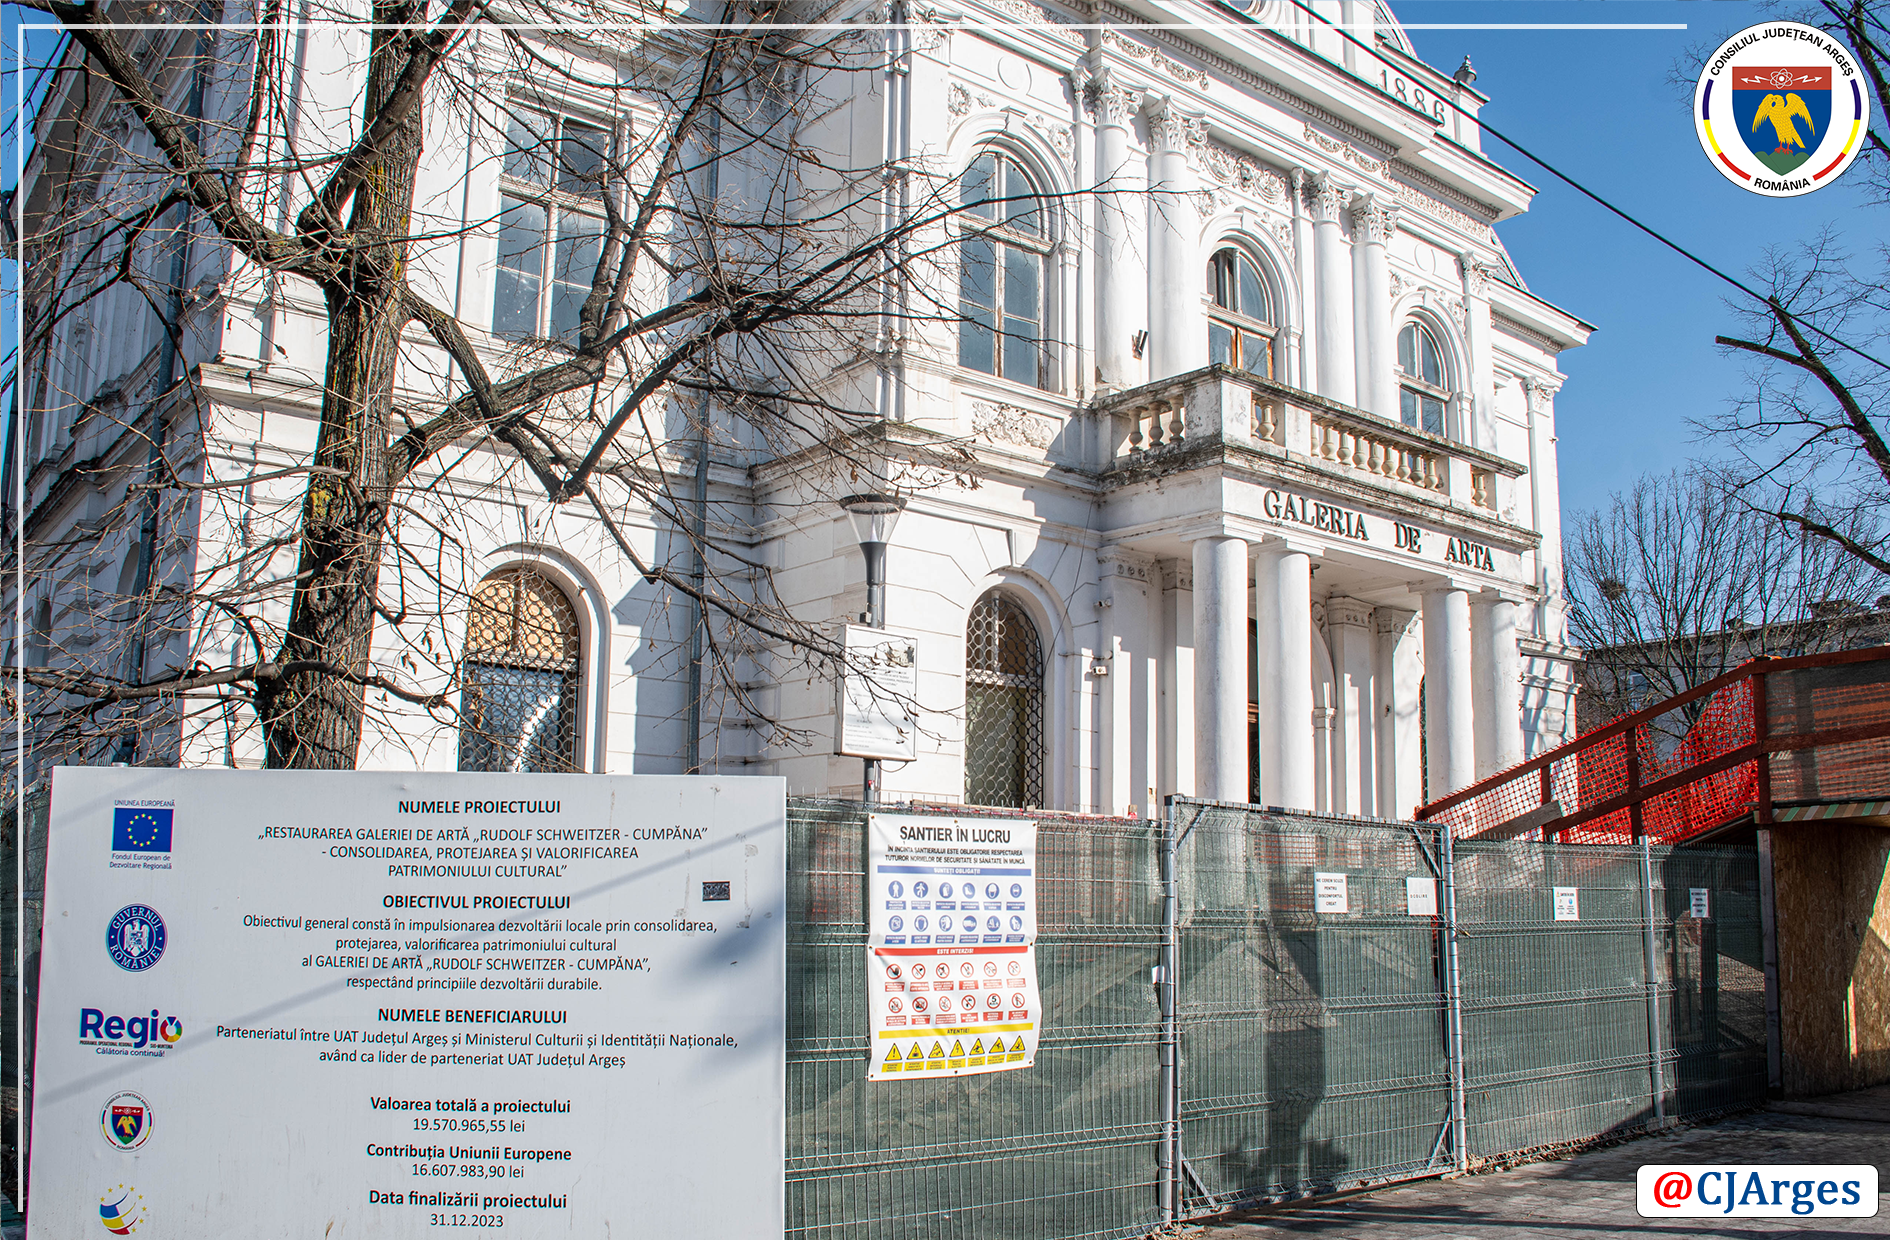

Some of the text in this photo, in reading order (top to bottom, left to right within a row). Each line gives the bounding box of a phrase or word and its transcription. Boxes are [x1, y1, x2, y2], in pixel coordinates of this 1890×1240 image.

[1379, 69, 1445, 127] 1886
[1263, 490, 1496, 572] GALERIA DE ARTA
[141, 799, 175, 807] EUROPEANĂ
[399, 801, 560, 813] NUMELE PROIECTULUI
[258, 826, 352, 840] „RESTAURAREA
[356, 828, 412, 840] GALERIEI
[417, 829, 433, 841] DE
[436, 826, 469, 841] ARTĂ
[473, 829, 532, 843] „RUDOLF
[537, 829, 620, 841] SCHWEITZER
[633, 825, 707, 840] CUMPĂNA”
[956, 825, 968, 842] ÎN
[972, 830, 1011, 843] LUCRU
[330, 846, 432, 861] CONSOLIDAREA,
[437, 847, 517, 859] PROTEJAREA
[536, 847, 638, 859] VALORIFICAREA
[960, 848, 990, 856] OBLIGATORIE
[389, 865, 567, 877] PATRIMONIULUI CULTURAL”
[383, 895, 570, 909] OBIECTIVUL PROIECTULUI
[112, 907, 164, 931] GUVERNUL
[244, 915, 717, 934] Obiectivul general constă în impulsionarea dezvoltării locale prin consolidarea,
[336, 937, 616, 953] protejarea, valorificarea patrimoniului cultural
[110, 945, 162, 969] ROMÂNIEI
[302, 955, 312, 966] al
[316, 955, 368, 968] GALERIEI
[373, 957, 388, 969] DE
[391, 954, 423, 969] ARTĂ
[426, 958, 482, 971] „RUDOLF
[486, 958, 565, 970] SCHWEITZER
[577, 956, 650, 972] CUMPĂNA”,
[347, 976, 601, 992] respectând principiile dezvoltării durabile.
[378, 1008, 566, 1024] NUMELE BENEFICIARULUI
[79, 1008, 183, 1049] Regio
[217, 1025, 737, 1049] Parteneriatul între UAT Județul Argeș și Ministerul Culturii și Identității Naționale,
[96, 1047, 129, 1056] Călătoria
[319, 1049, 625, 1069] având ca lider de parteneriat UAT Județul Argeș
[370, 1097, 570, 1115] Valoarea totală a proiectului
[414, 1118, 525, 1134] 19.570.965,55 lei
[367, 1144, 571, 1163] Contribuția Uniunii Europene
[413, 1164, 524, 1179] 16.607.983,90 lei
[370, 1190, 566, 1210] Data finalizării proiectului
[431, 1213, 503, 1227] 31.12.2023
